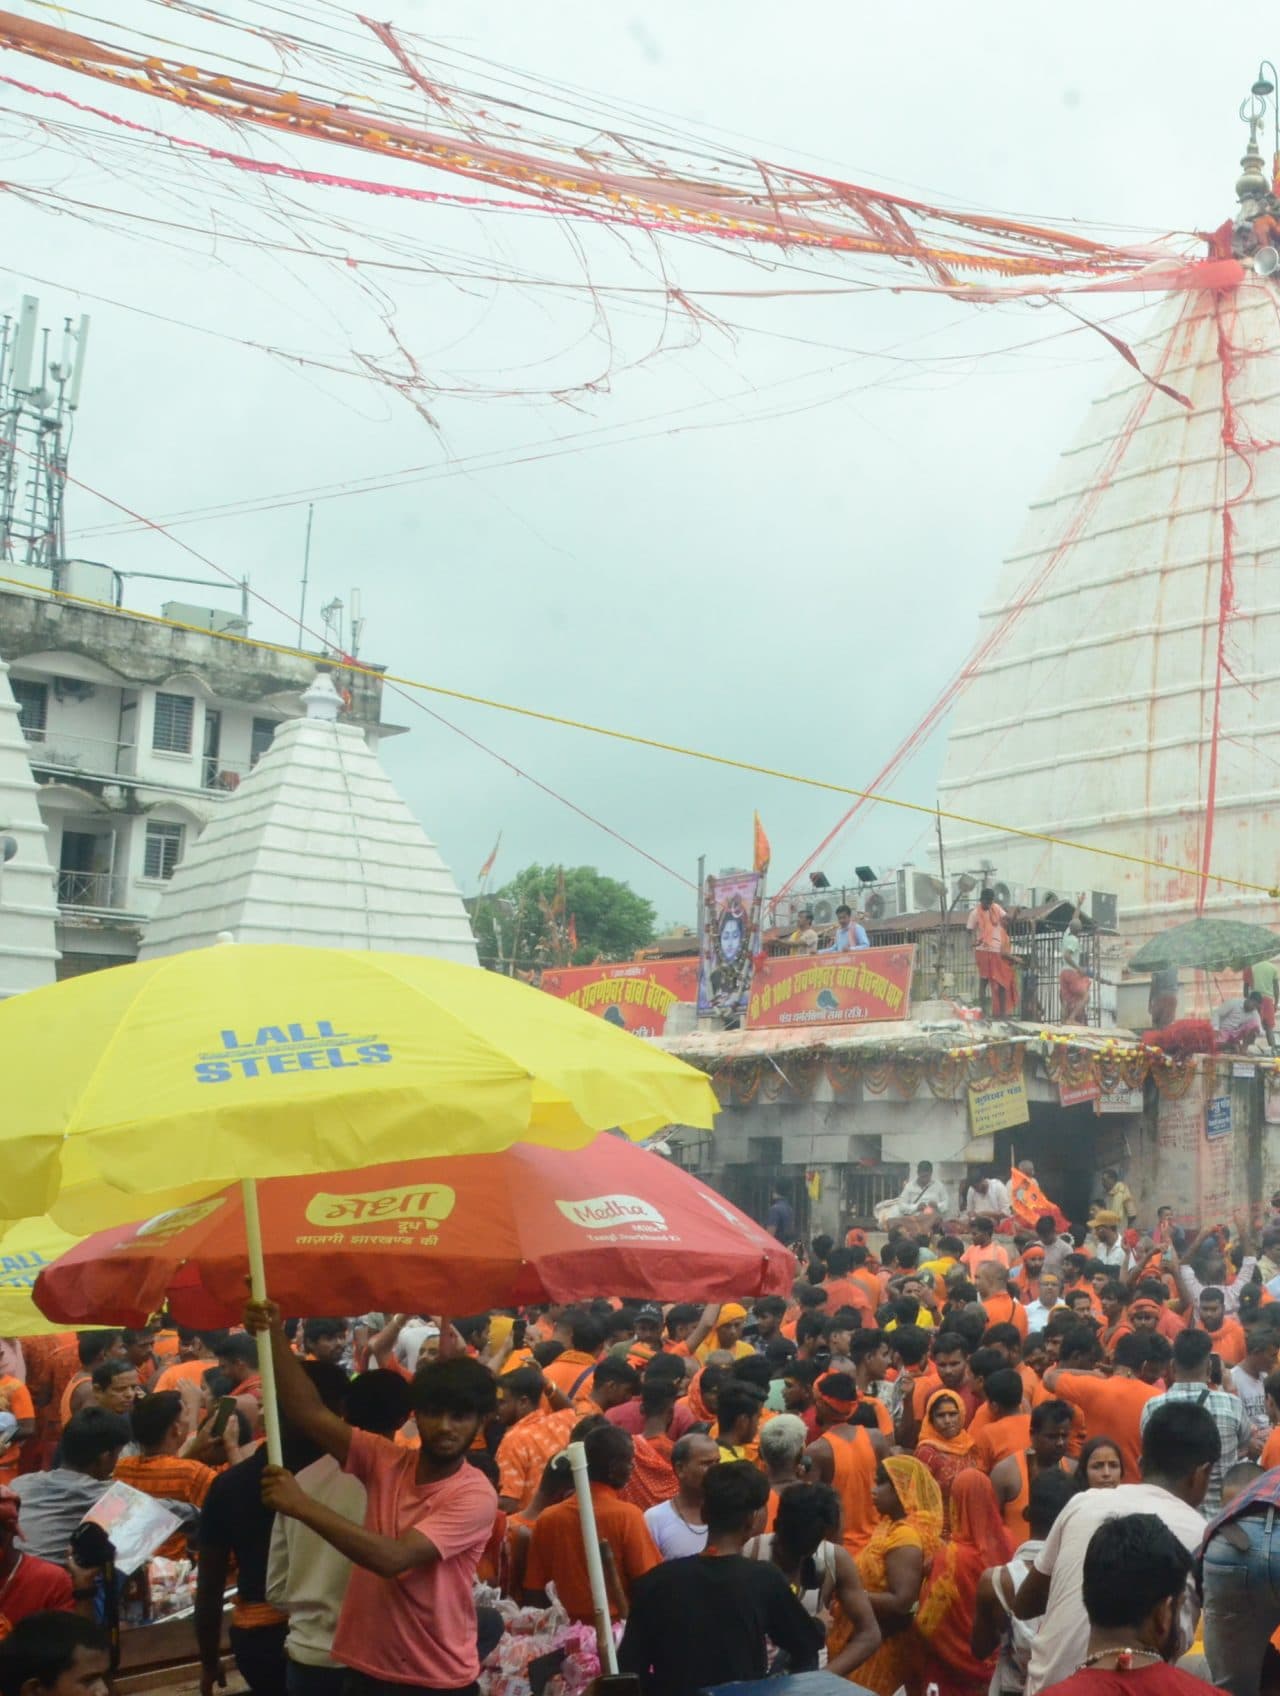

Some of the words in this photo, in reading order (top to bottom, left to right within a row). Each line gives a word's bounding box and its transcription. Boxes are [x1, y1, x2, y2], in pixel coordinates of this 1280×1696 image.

[220, 1019, 350, 1049] LALL
[193, 1042, 393, 1083] STEELS
[324, 1191, 441, 1219] मेधा
[572, 1201, 646, 1222] Medha
[420, 1234, 439, 1247] की
[0, 1251, 51, 1275] ALL
